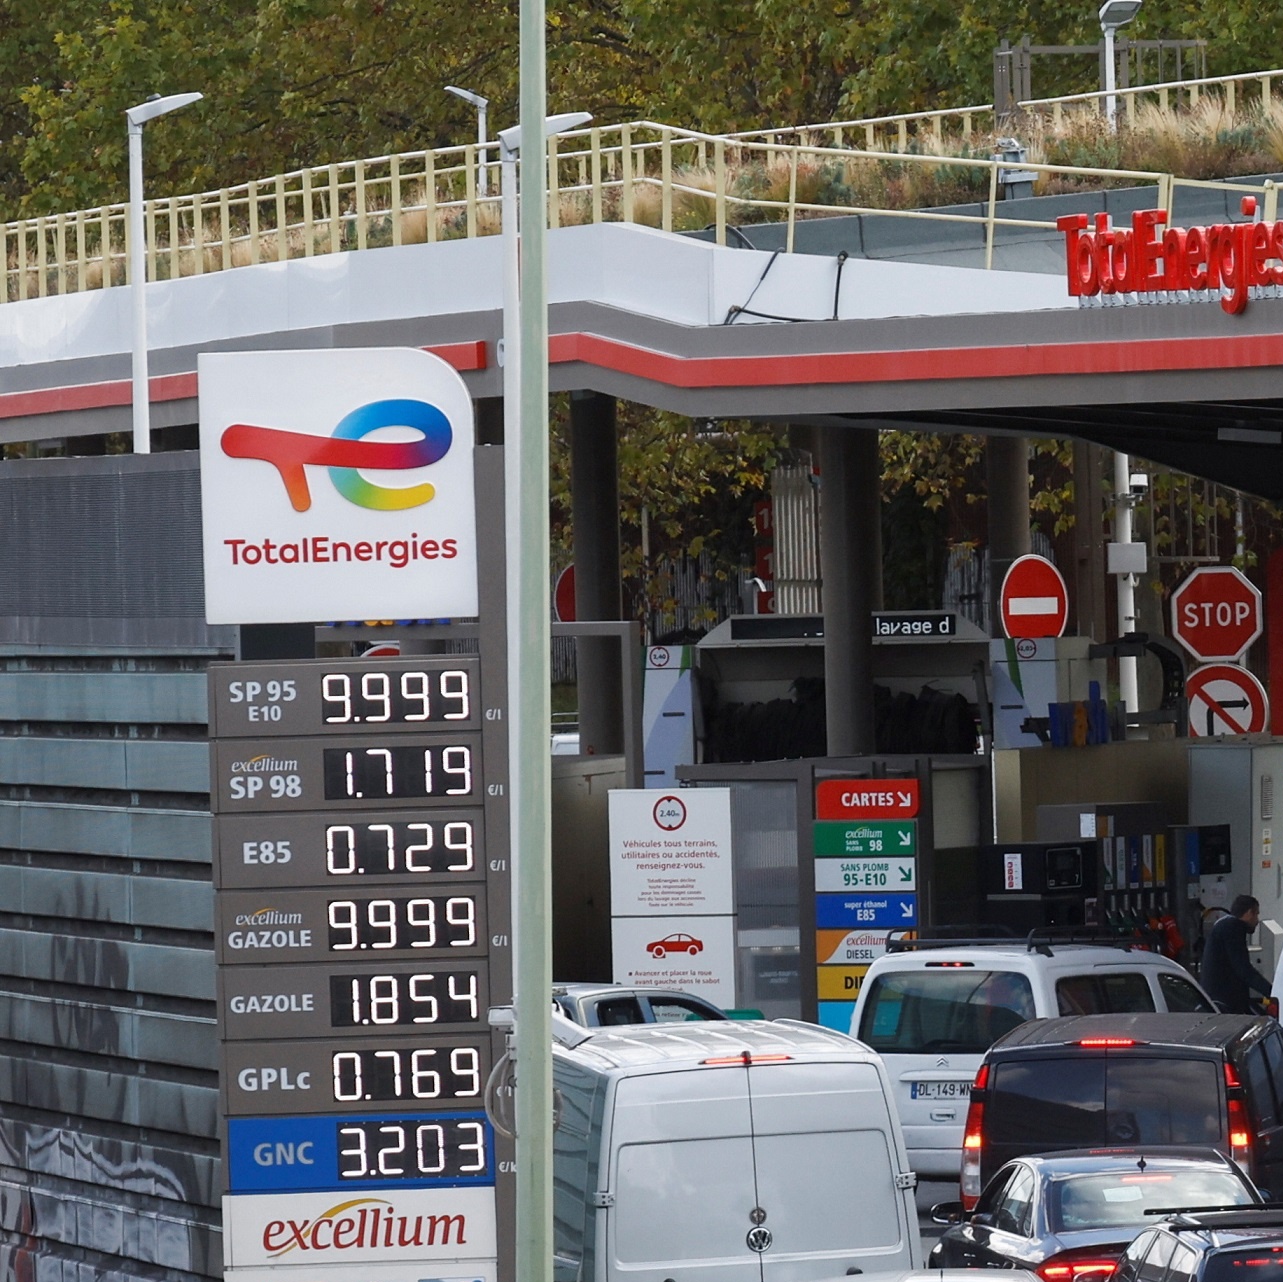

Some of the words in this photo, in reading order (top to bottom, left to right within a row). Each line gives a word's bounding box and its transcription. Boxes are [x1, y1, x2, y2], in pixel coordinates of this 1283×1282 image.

[224, 532, 458, 568] TotalEnergies
[1183, 602, 1251, 628] STOP
[876, 618, 931, 636] lavage
[229, 682, 262, 703] SP
[267, 680, 297, 702] 95
[322, 671, 470, 723] 9.999
[248, 706, 282, 722] E10
[230, 777, 263, 799] SP
[269, 775, 302, 798] 98
[345, 746, 472, 798] 1.719
[231, 755, 298, 773] excellium
[841, 792, 894, 807] CARTES
[845, 828, 883, 839] excellium
[243, 841, 292, 864] E85
[326, 822, 474, 874] 0.729
[622, 839, 661, 848] Véhicules
[664, 840, 682, 848] tous
[869, 840, 883, 851] 98
[621, 850, 661, 859] utilitaires
[840, 863, 861, 872] SANS
[862, 863, 889, 871] PLOMB
[843, 873, 887, 887] 95-E10
[844, 901, 862, 909] super
[228, 930, 312, 949] GAZOLE
[328, 897, 476, 950] 9.999
[235, 909, 302, 926] excellium
[857, 909, 876, 921] E85
[846, 949, 875, 960] DIESEL
[230, 994, 314, 1013] GAZOLE
[352, 974, 478, 1025] 1.854
[238, 1068, 311, 1092] GPLc
[333, 1048, 480, 1101] 0.769
[253, 1142, 314, 1166] GNC
[340, 1122, 485, 1177] 3.203
[263, 1202, 467, 1253] excellium
